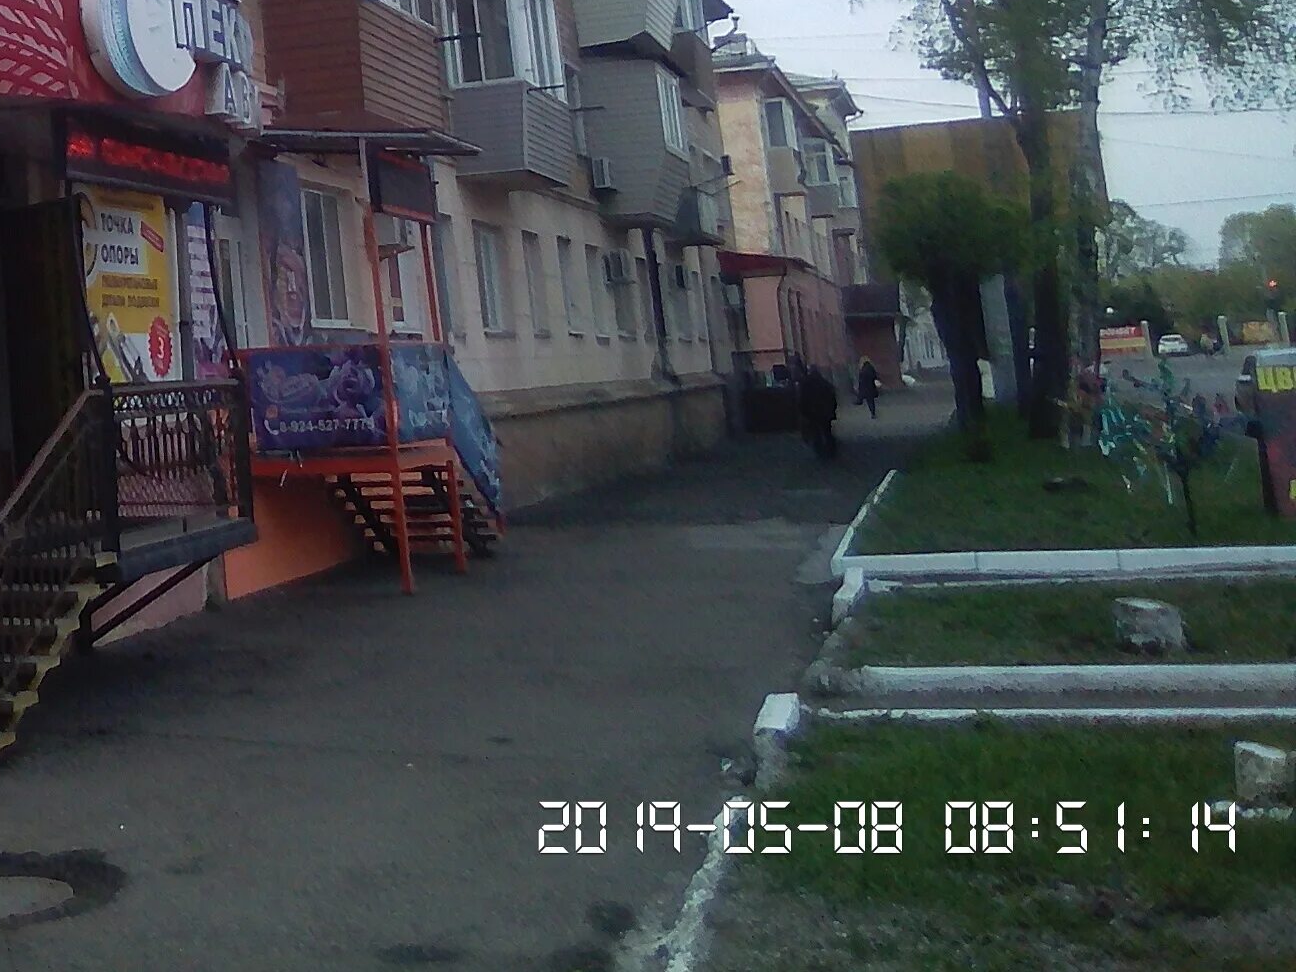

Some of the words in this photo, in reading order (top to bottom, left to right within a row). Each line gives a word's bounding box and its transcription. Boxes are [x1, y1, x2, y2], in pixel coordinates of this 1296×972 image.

[100, 212, 134, 234] ТОЧКА
[100, 243, 139, 265] ОПОРЫ
[1256, 365, 1296, 393] ЦВ
